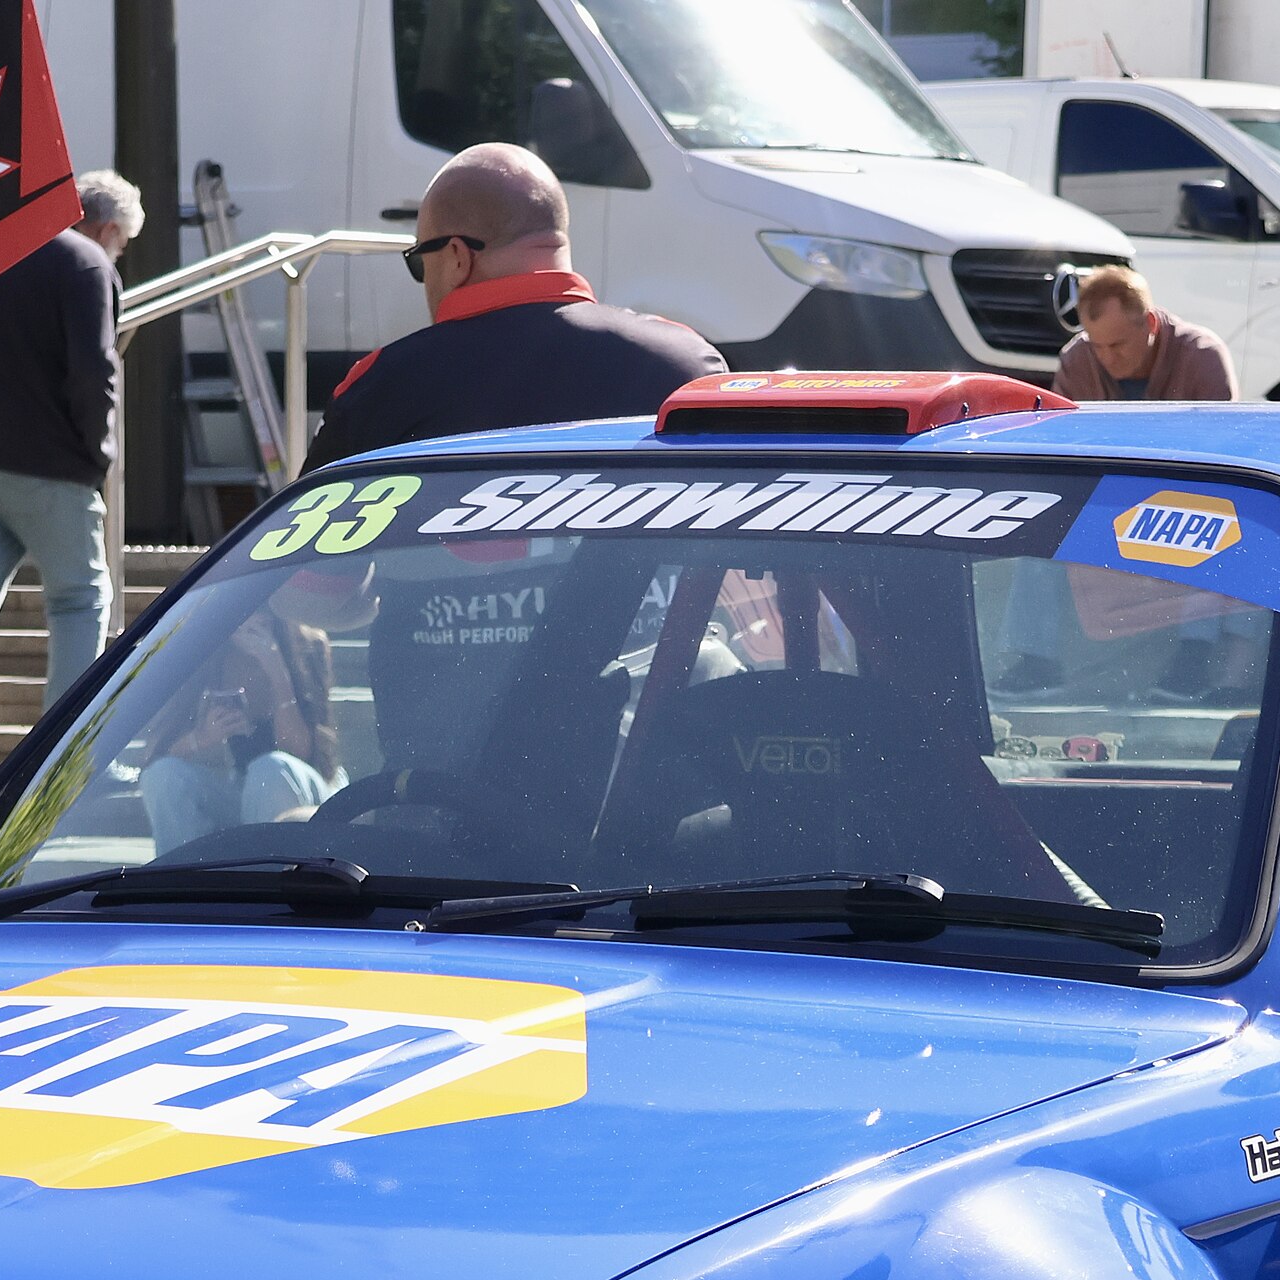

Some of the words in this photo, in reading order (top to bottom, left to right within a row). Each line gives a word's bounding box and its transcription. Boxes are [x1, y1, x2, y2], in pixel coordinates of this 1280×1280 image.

[772, 380, 832, 389] AUTO
[831, 379, 907, 388] PARTS
[249, 475, 422, 561] 33
[418, 473, 1062, 540] ShowTime
[1127, 506, 1222, 550] NAPA
